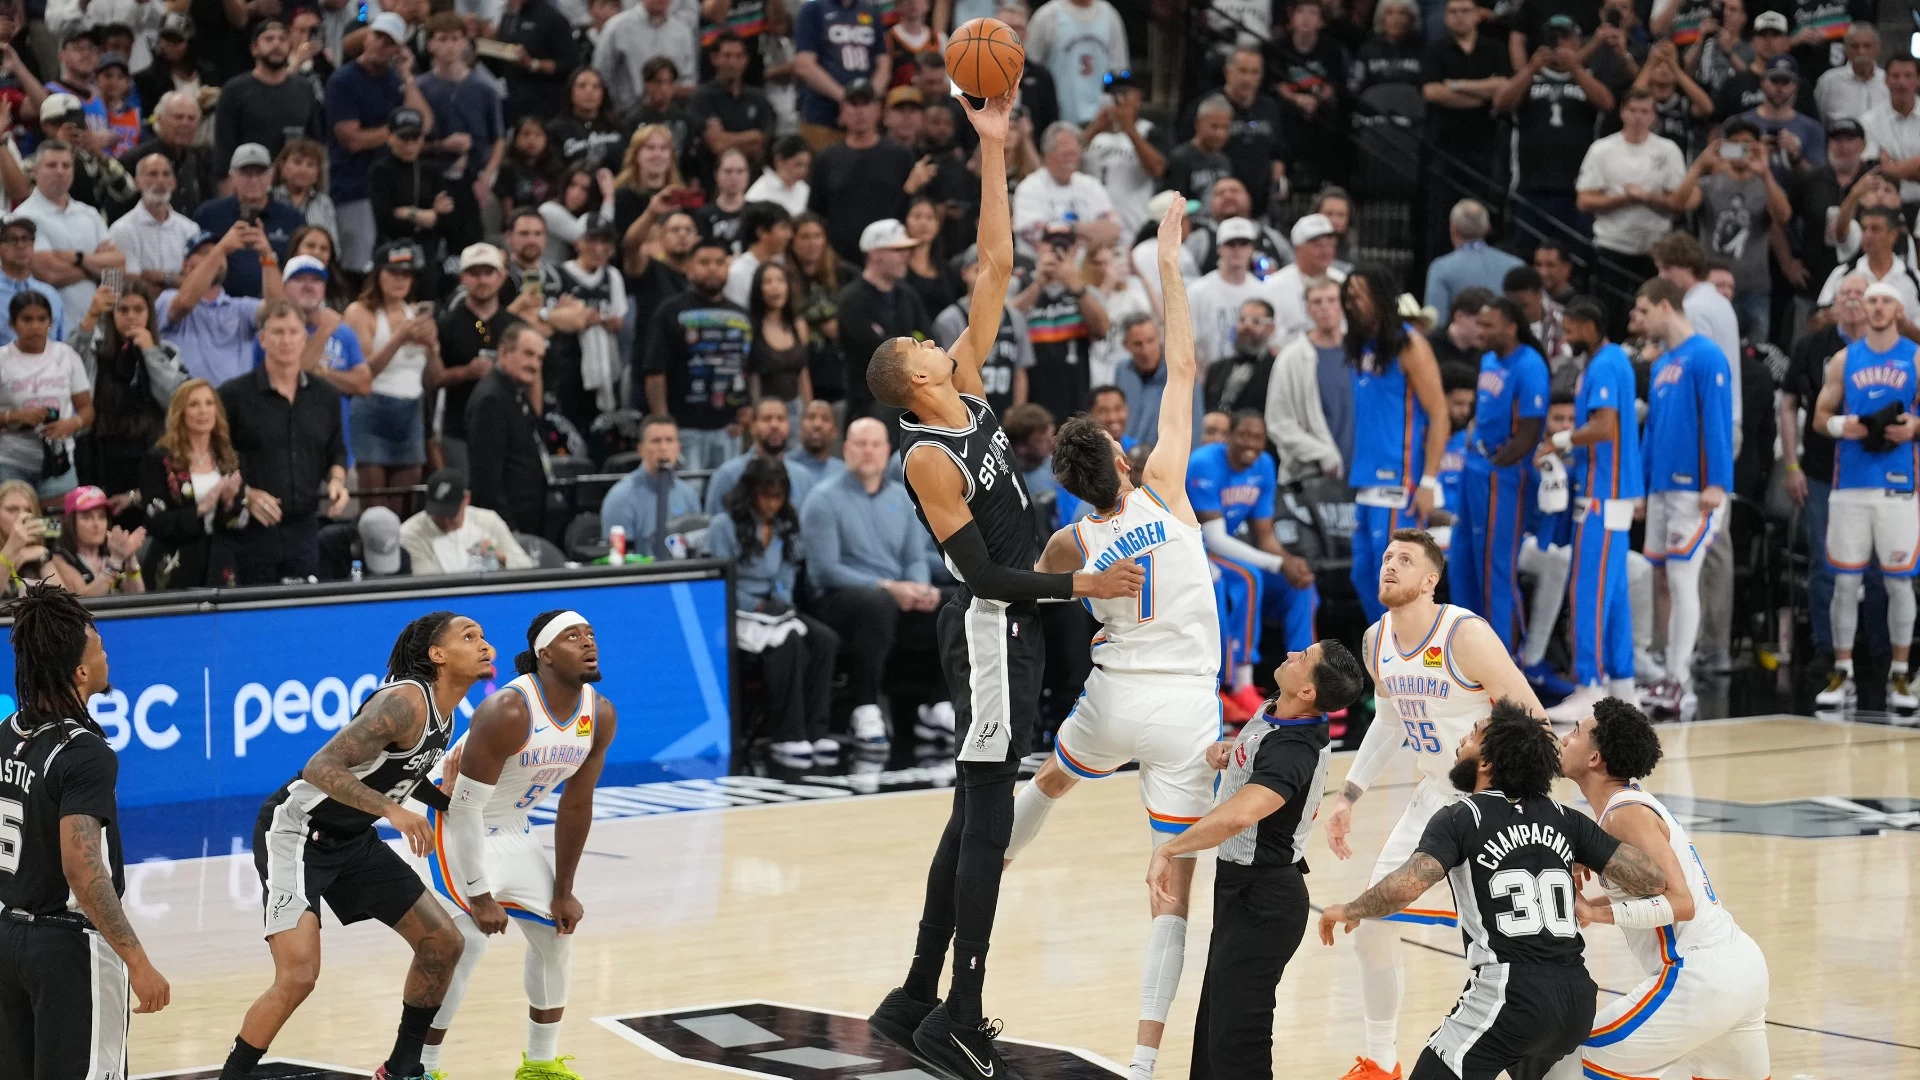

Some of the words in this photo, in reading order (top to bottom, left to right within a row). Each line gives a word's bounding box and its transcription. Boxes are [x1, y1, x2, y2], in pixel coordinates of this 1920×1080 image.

[1550, 103, 1563, 127] 1
[1851, 366, 1908, 390] THUNDER
[1011, 471, 1029, 511] 1
[1093, 520, 1167, 572] HOLMGREN
[1384, 674, 1451, 700] KLAHOMA
[86, 683, 182, 753] BC
[234, 673, 388, 758] peac
[1398, 698, 1428, 719] CITY
[1403, 719, 1443, 755] 55
[0, 757, 36, 795] STLE
[402, 747, 446, 771] SPUR
[531, 767, 567, 783] CITY
[513, 783, 549, 811] 5
[0, 796, 24, 876] 5
[1476, 822, 1575, 871] CHAMPAGNIE
[1488, 868, 1579, 938] 30
